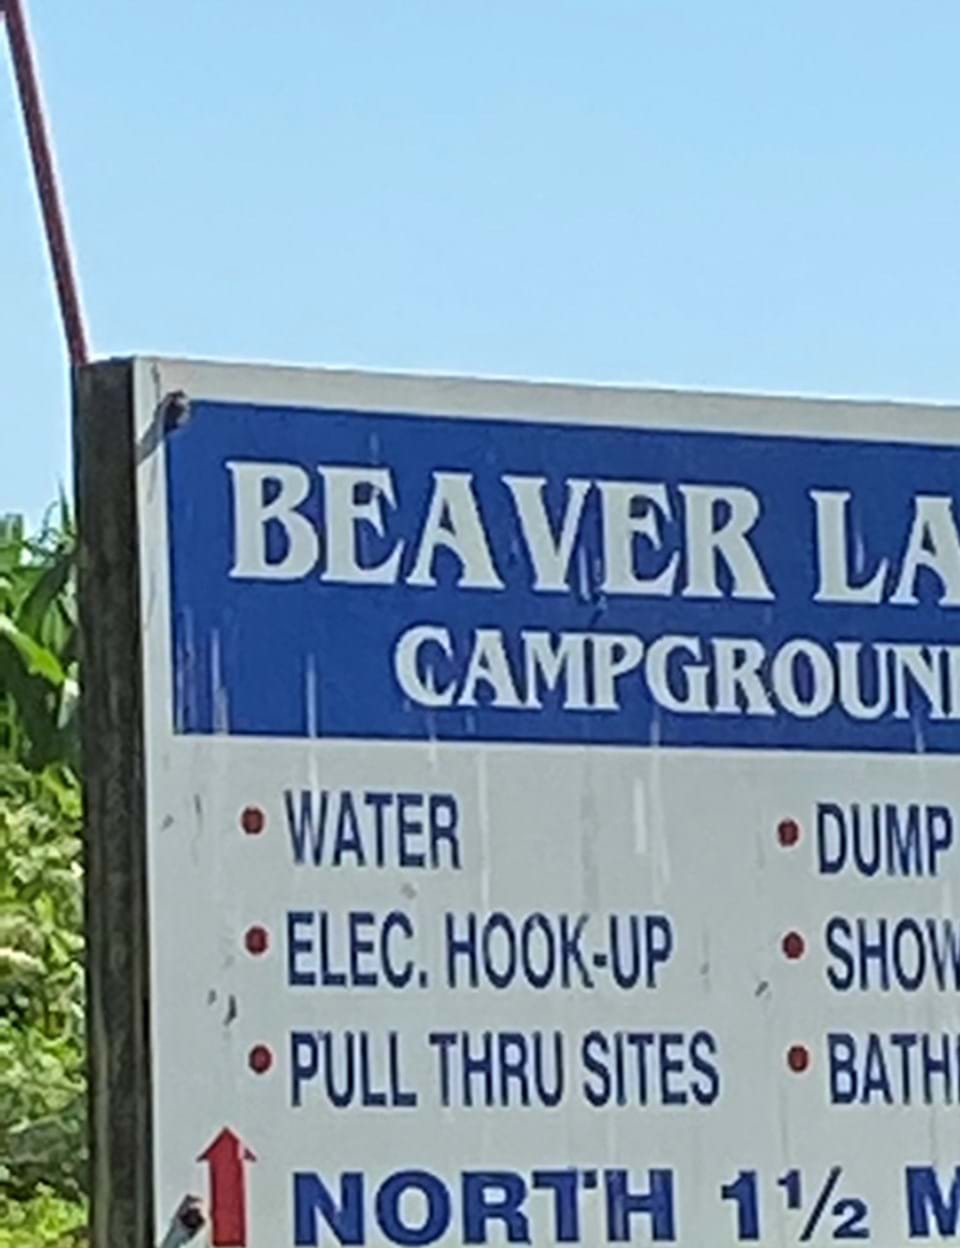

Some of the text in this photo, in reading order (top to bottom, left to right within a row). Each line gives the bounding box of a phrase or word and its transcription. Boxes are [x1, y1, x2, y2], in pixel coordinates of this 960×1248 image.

[226, 461, 774, 599] BEAVER
[283, 789, 462, 870] WATER
[816, 802, 954, 878] DUMP
[286, 910, 673, 990] ELEC. HOOK-UP
[290, 1030, 720, 1109] PULL THRU SITES
[292, 1167, 677, 1248] NORTH
